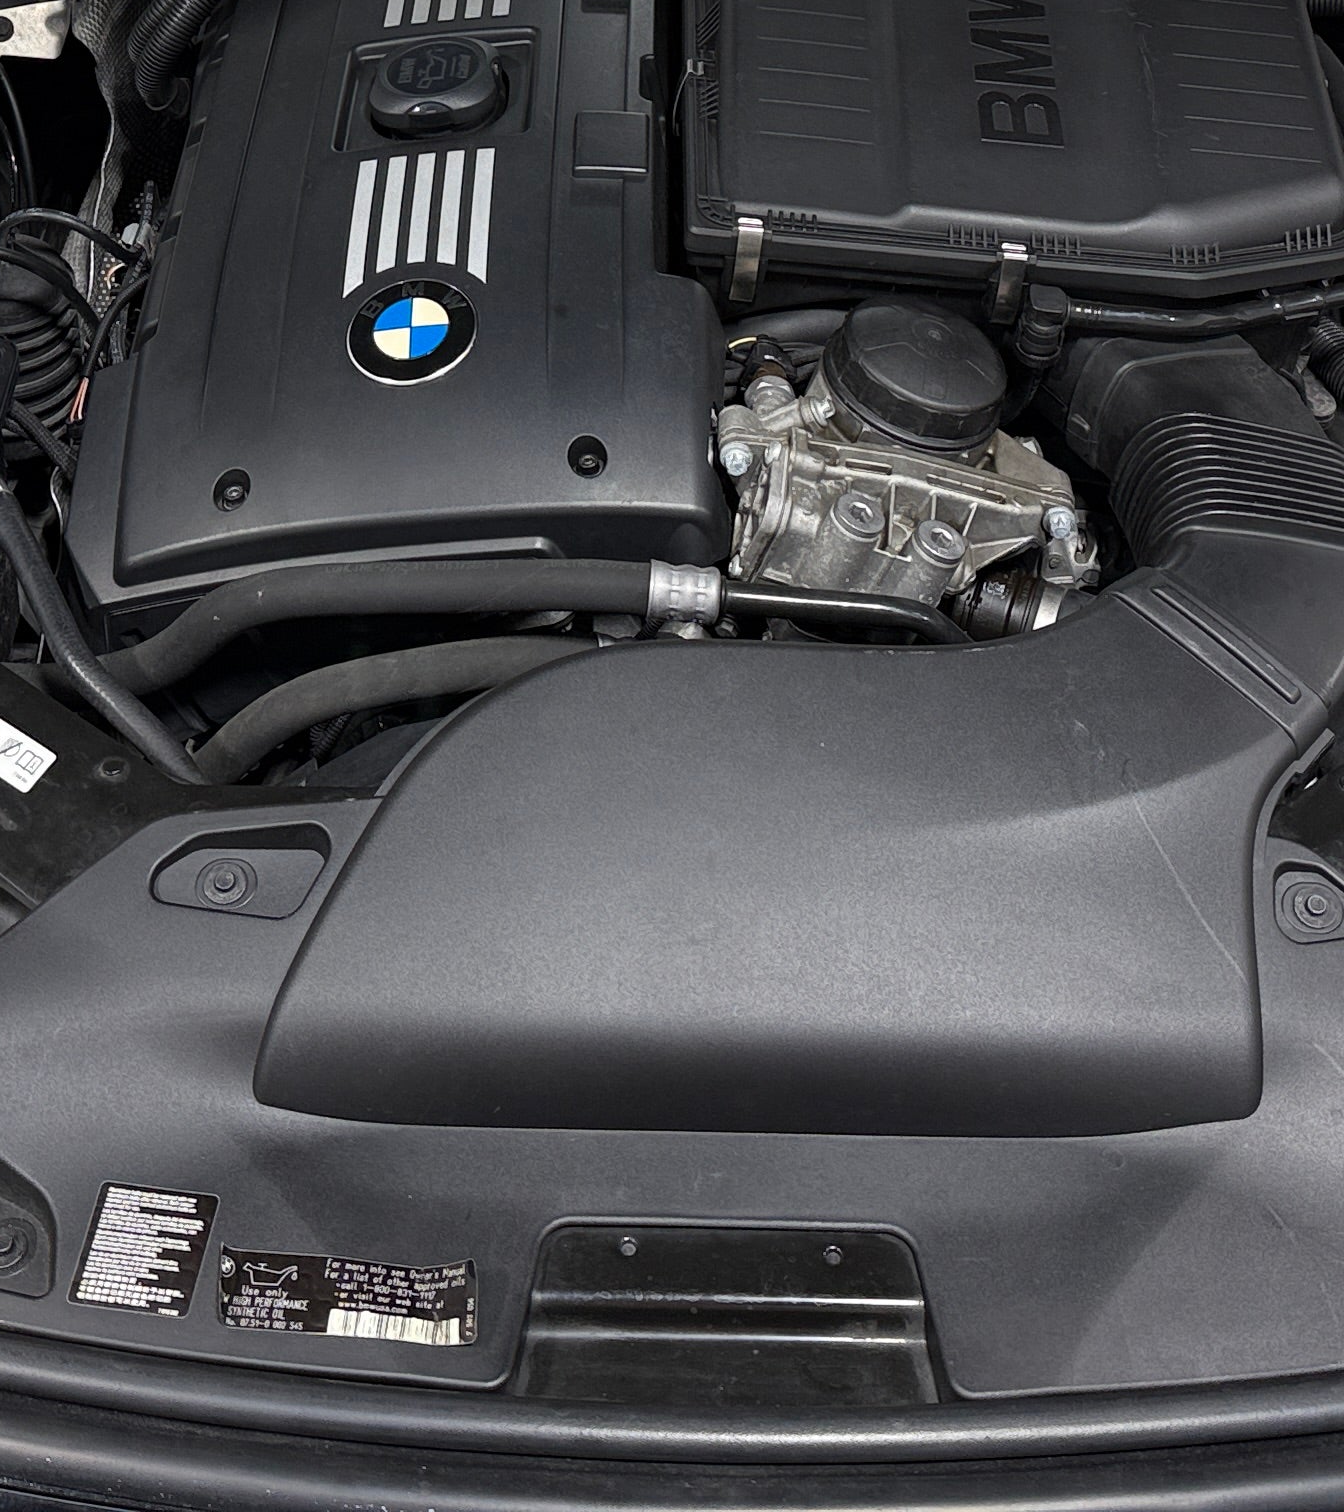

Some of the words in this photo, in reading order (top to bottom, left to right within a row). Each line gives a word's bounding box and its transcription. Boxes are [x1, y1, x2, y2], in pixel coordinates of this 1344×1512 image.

[360, 280, 467, 318] BMW
[325, 1258, 341, 1268] For
[344, 1262, 365, 1271] more
[369, 1264, 387, 1274] info
[390, 1269, 405, 1278] see
[409, 1269, 439, 1280] Owner's
[324, 1268, 340, 1279] For
[353, 1273, 369, 1282] list
[373, 1275, 383, 1284] of
[387, 1276, 410, 1288] other
[413, 1278, 449, 1291] approved
[451, 1277, 466, 1288] oils
[241, 1285, 259, 1296] Use
[265, 1287, 288, 1300] only
[353, 1291, 374, 1301] visit
[395, 1298, 411, 1306] web
[415, 1300, 432, 1309] site
[436, 1300, 444, 1309] at
[232, 1295, 251, 1307] HIGH
[254, 1296, 310, 1311] PERFORMANCE
[226, 1306, 269, 1318] SYNTHETIC
[272, 1309, 285, 1320] OIL
